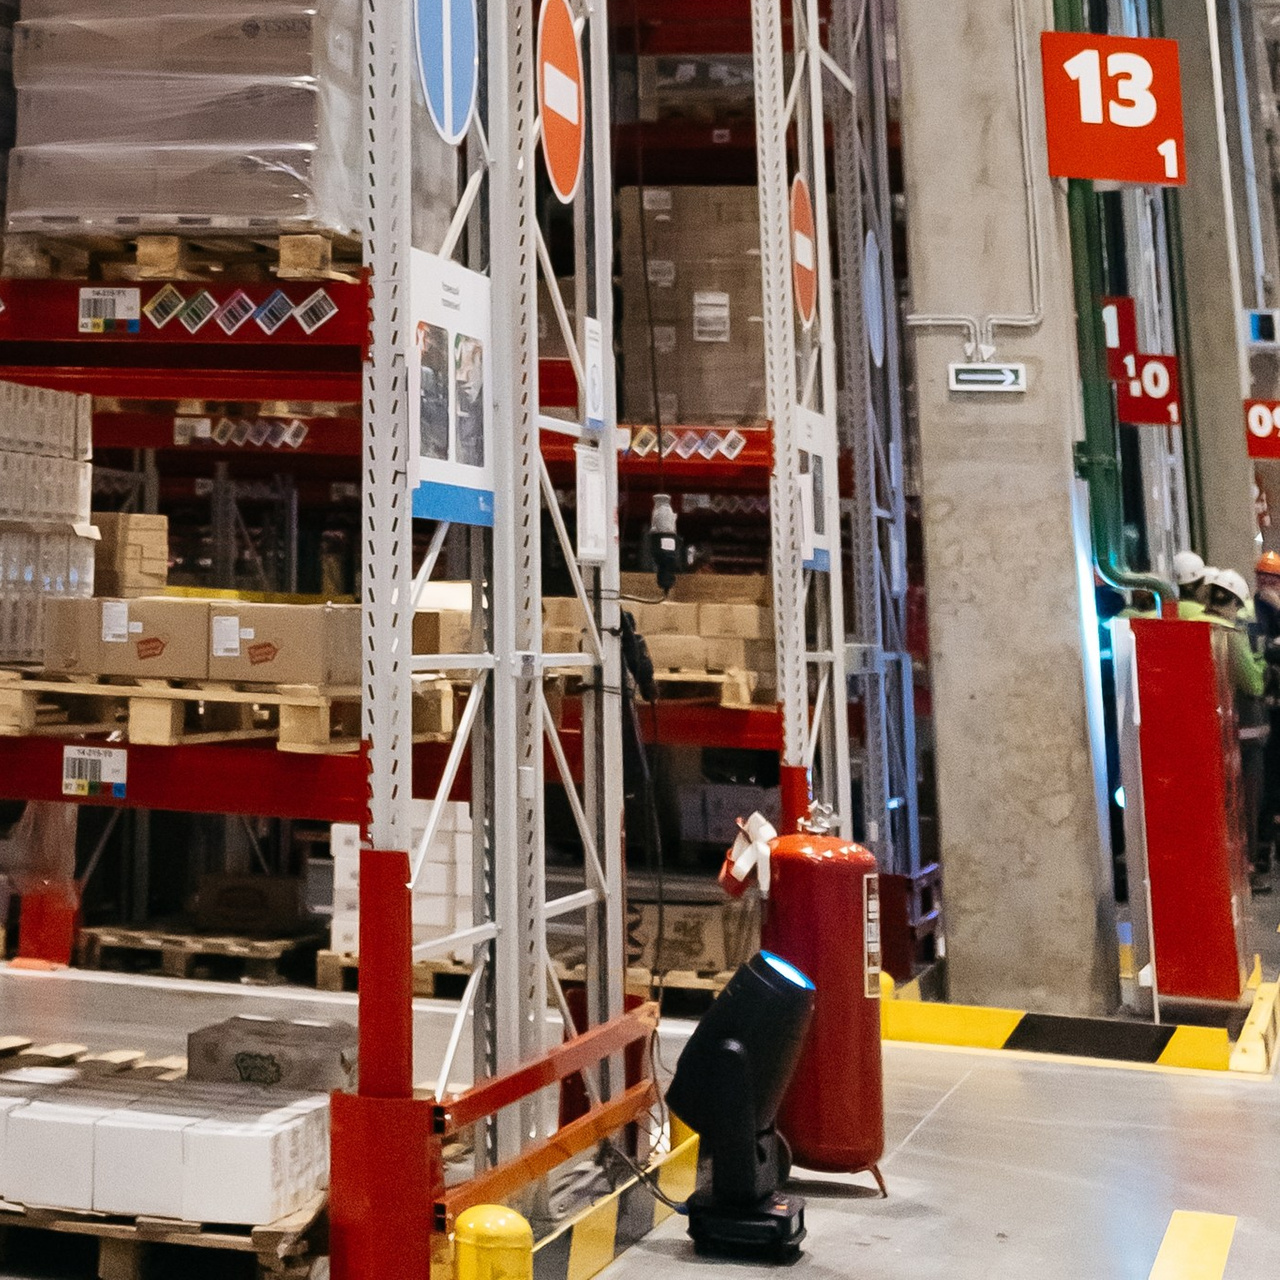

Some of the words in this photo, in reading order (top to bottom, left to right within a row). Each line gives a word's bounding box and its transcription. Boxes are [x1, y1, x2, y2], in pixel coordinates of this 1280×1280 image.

[1063, 50, 1157, 127] 13
[1157, 140, 1178, 178] 1
[1102, 305, 1119, 349] 1
[1123, 354, 1136, 378] 1
[1167, 402, 1179, 422] 1
